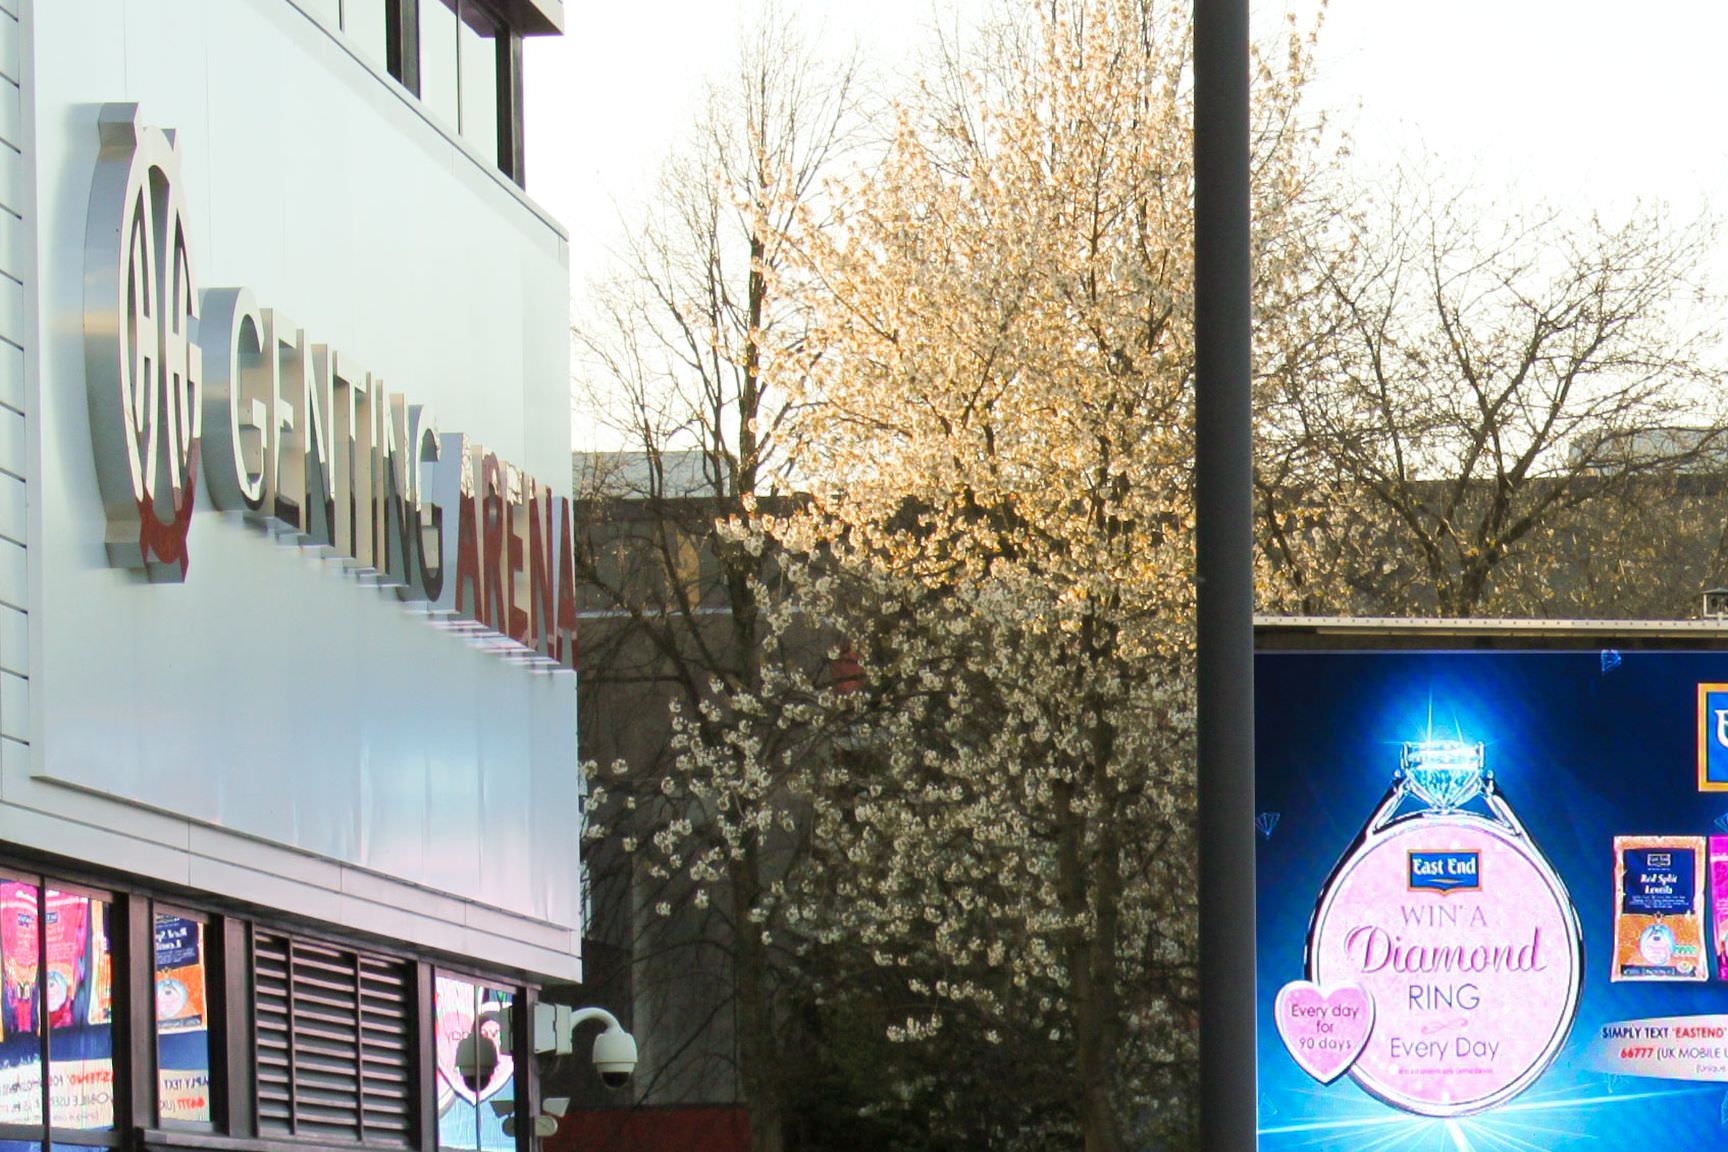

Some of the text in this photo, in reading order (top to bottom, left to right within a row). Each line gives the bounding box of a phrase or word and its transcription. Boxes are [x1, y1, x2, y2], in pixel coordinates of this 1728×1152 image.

[226, 286, 580, 672] GENTING ARENA
[1412, 857, 1476, 876] East End
[1469, 905, 1488, 928] A
[1344, 925, 1549, 974] Diamond
[1409, 983, 1481, 1011] RING
[1291, 1004, 1359, 1020] Every day
[1316, 1020, 1333, 1033] for
[1602, 1027, 1642, 1039] SIMPLY
[1646, 1027, 1668, 1039] TEXT
[1299, 1037, 1352, 1051] 90 days
[1391, 1037, 1500, 1062] Every Day
[1620, 1047, 1654, 1059] 66777
[1678, 1047, 1721, 1059] MOBILE
